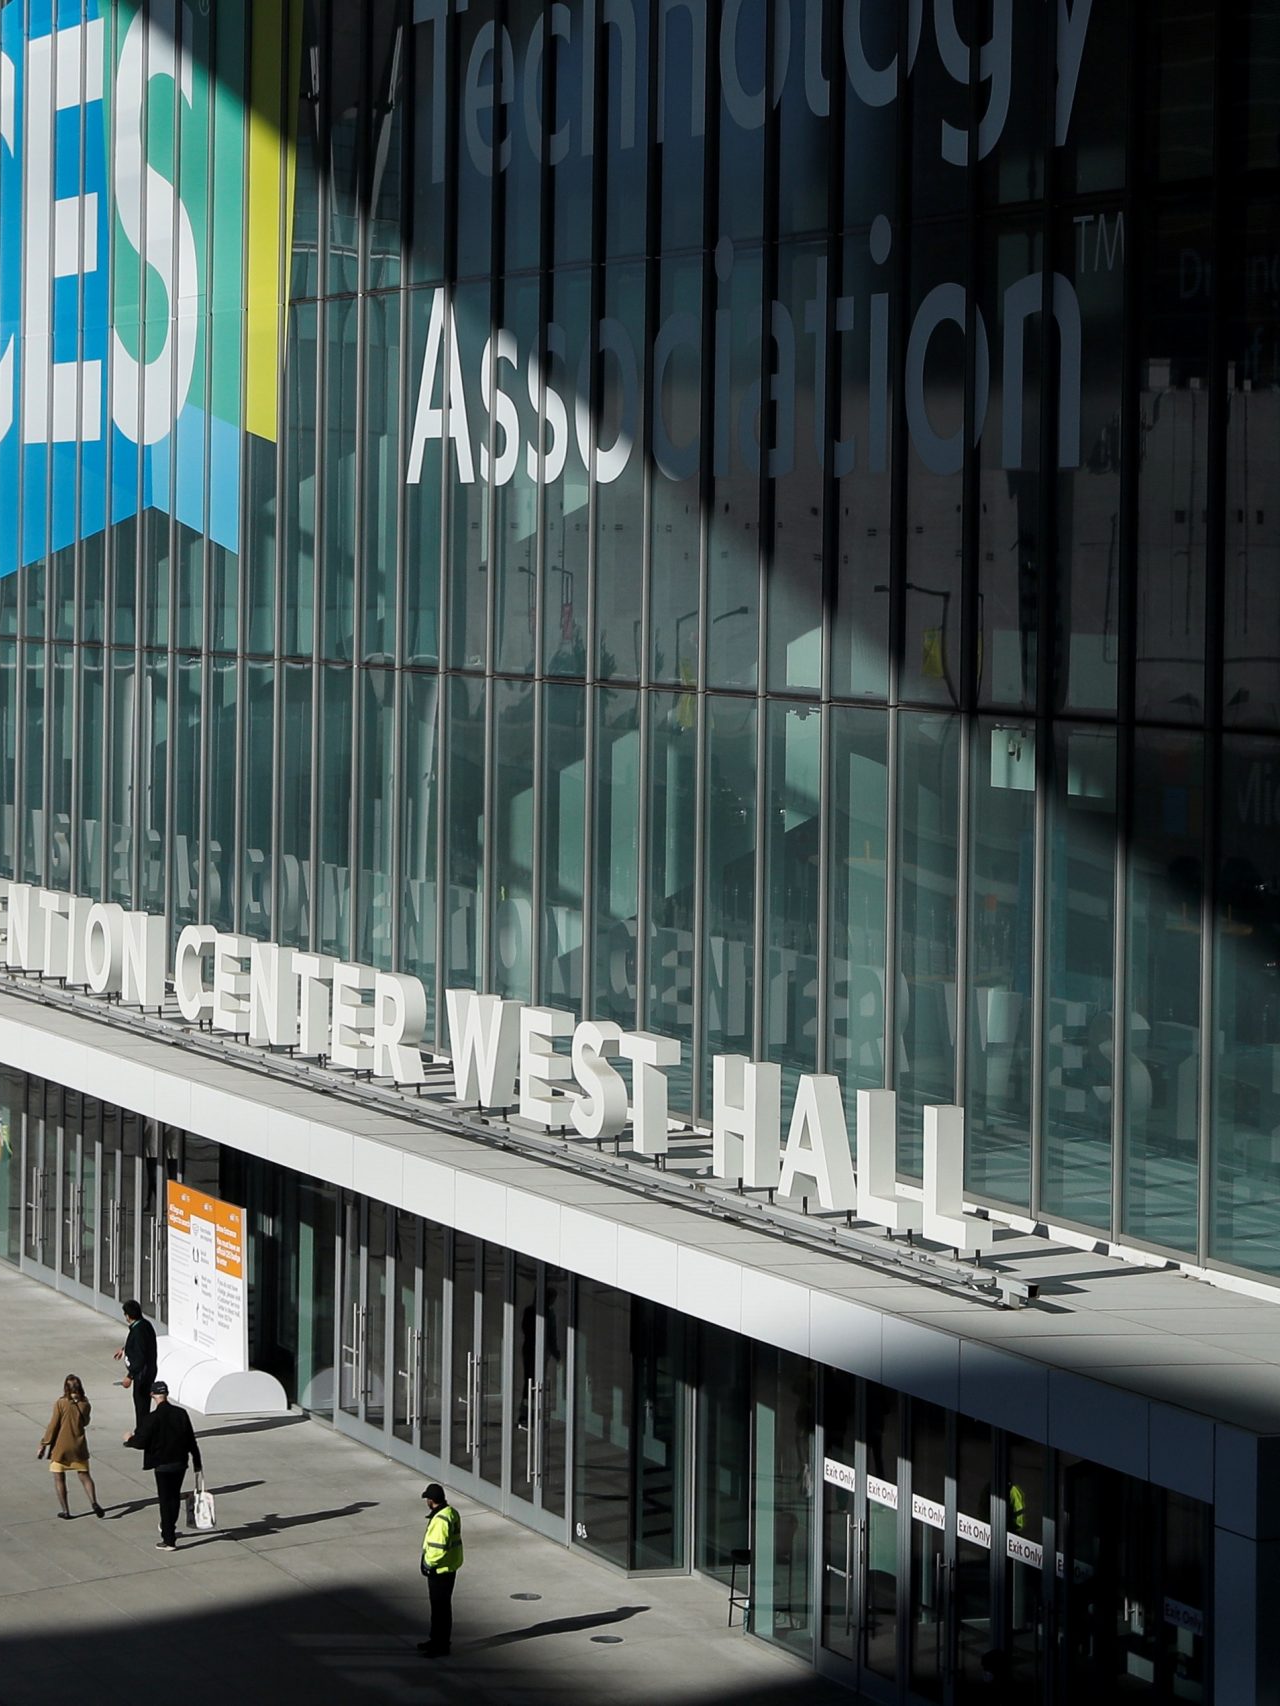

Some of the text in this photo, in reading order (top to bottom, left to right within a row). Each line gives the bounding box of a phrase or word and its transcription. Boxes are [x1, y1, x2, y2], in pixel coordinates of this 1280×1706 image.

[406, 214, 1082, 488] Association
[175, 924, 427, 1083] CENTER
[445, 988, 681, 1154] WEST
[713, 1053, 994, 1251] HALL
[825, 1464, 854, 1488] Exit Only
[868, 1481, 897, 1507] Exit Only
[913, 1501, 944, 1526] Exit Only
[958, 1520, 990, 1546] Exit Only
[1008, 1540, 1042, 1565] Exit Only
